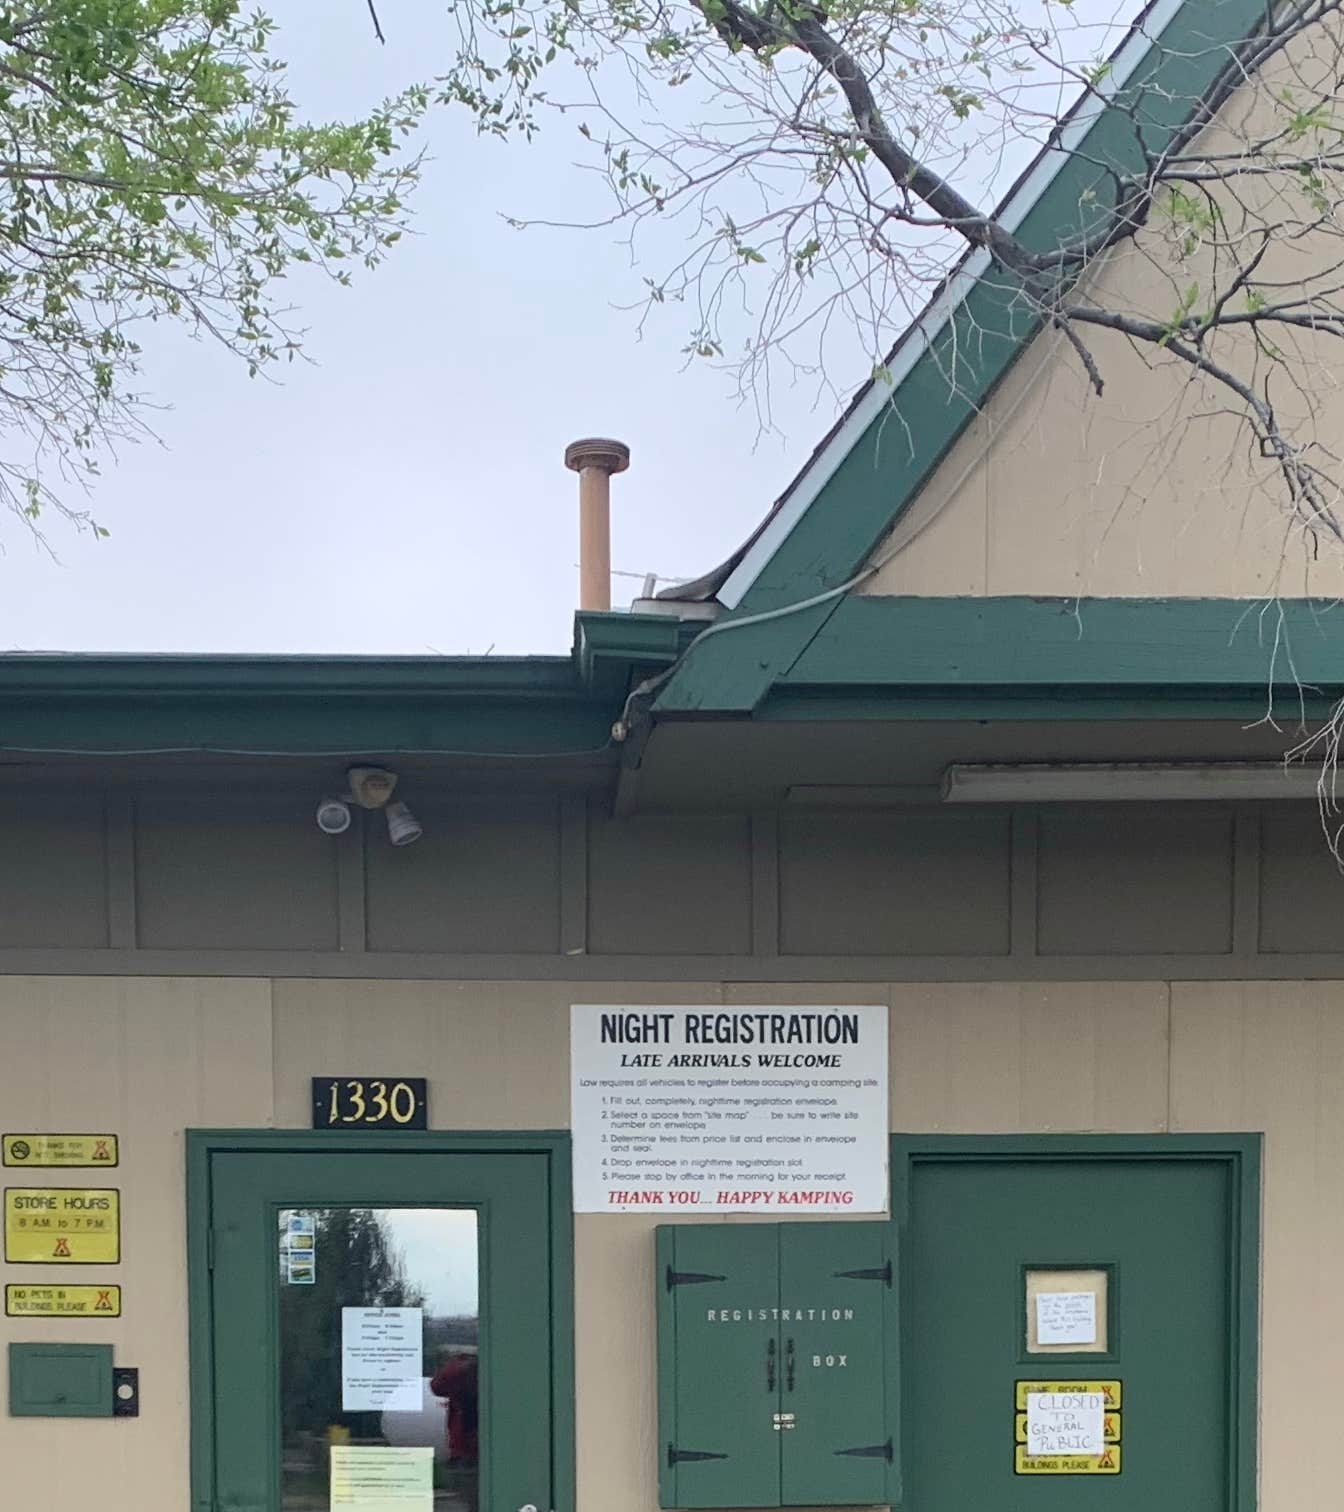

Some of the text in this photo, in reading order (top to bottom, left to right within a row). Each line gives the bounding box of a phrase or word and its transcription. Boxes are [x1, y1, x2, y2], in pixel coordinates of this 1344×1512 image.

[600, 1014, 859, 1044] NIGHT REGISTRATION
[620, 1053, 843, 1068] LATE ARRIVALS WELCOME
[599, 1079, 634, 1088] requires
[637, 1079, 648, 1087] all
[649, 1079, 686, 1087] vehicles
[687, 1079, 696, 1087] to
[697, 1079, 729, 1089] register
[730, 1079, 760, 1087] before
[761, 1079, 810, 1089] occupying
[819, 1079, 862, 1089] camping
[329, 1081, 415, 1124] 1330
[610, 1096, 623, 1105] Fill
[699, 1096, 740, 1107] nighttime
[743, 1096, 793, 1107] registration
[610, 1111, 638, 1119] Select
[650, 1112, 679, 1121] space
[682, 1111, 702, 1119] from
[771, 1111, 784, 1119] be
[786, 1111, 805, 1119] sure
[808, 1111, 817, 1119] to
[819, 1111, 841, 1119] write
[843, 1111, 858, 1119] site
[610, 1121, 646, 1129] number
[610, 1134, 657, 1143] Determine
[659, 1134, 676, 1143] fees
[680, 1134, 700, 1143] from
[702, 1134, 727, 1144] price
[729, 1134, 741, 1143] list
[743, 1135, 763, 1143] and
[765, 1135, 801, 1143] enclose
[803, 1134, 812, 1143] in
[815, 1135, 857, 1144] envelope
[610, 1144, 630, 1152] and
[610, 1158, 632, 1168] Drop
[635, 1158, 677, 1168] envelope
[679, 1158, 688, 1167] in
[690, 1158, 733, 1168] nighttime
[736, 1158, 785, 1168] registration
[611, 1172, 641, 1180] Please
[643, 1172, 662, 1182] stop
[665, 1172, 676, 1182] by
[679, 1172, 705, 1180] office
[707, 1172, 716, 1180] in
[719, 1172, 734, 1180] the
[736, 1172, 775, 1182] morning
[777, 1172, 789, 1180] for
[791, 1174, 811, 1182] your
[608, 1191, 664, 1204] THANK
[716, 1191, 774, 1204] HAPPY
[777, 1191, 854, 1204] KAMPING
[14, 1196, 110, 1210] STORE HOURS
[14, 1290, 26, 1299] NO
[707, 1309, 854, 1322] REGISTRATION
[813, 1354, 848, 1367] BOX
[1038, 1395, 1099, 1410] CLOSED
[1050, 1412, 1075, 1421] TO
[1031, 1422, 1085, 1436] GENERAL
[1022, 1461, 1090, 1469] BUILDINGS PLEASE
